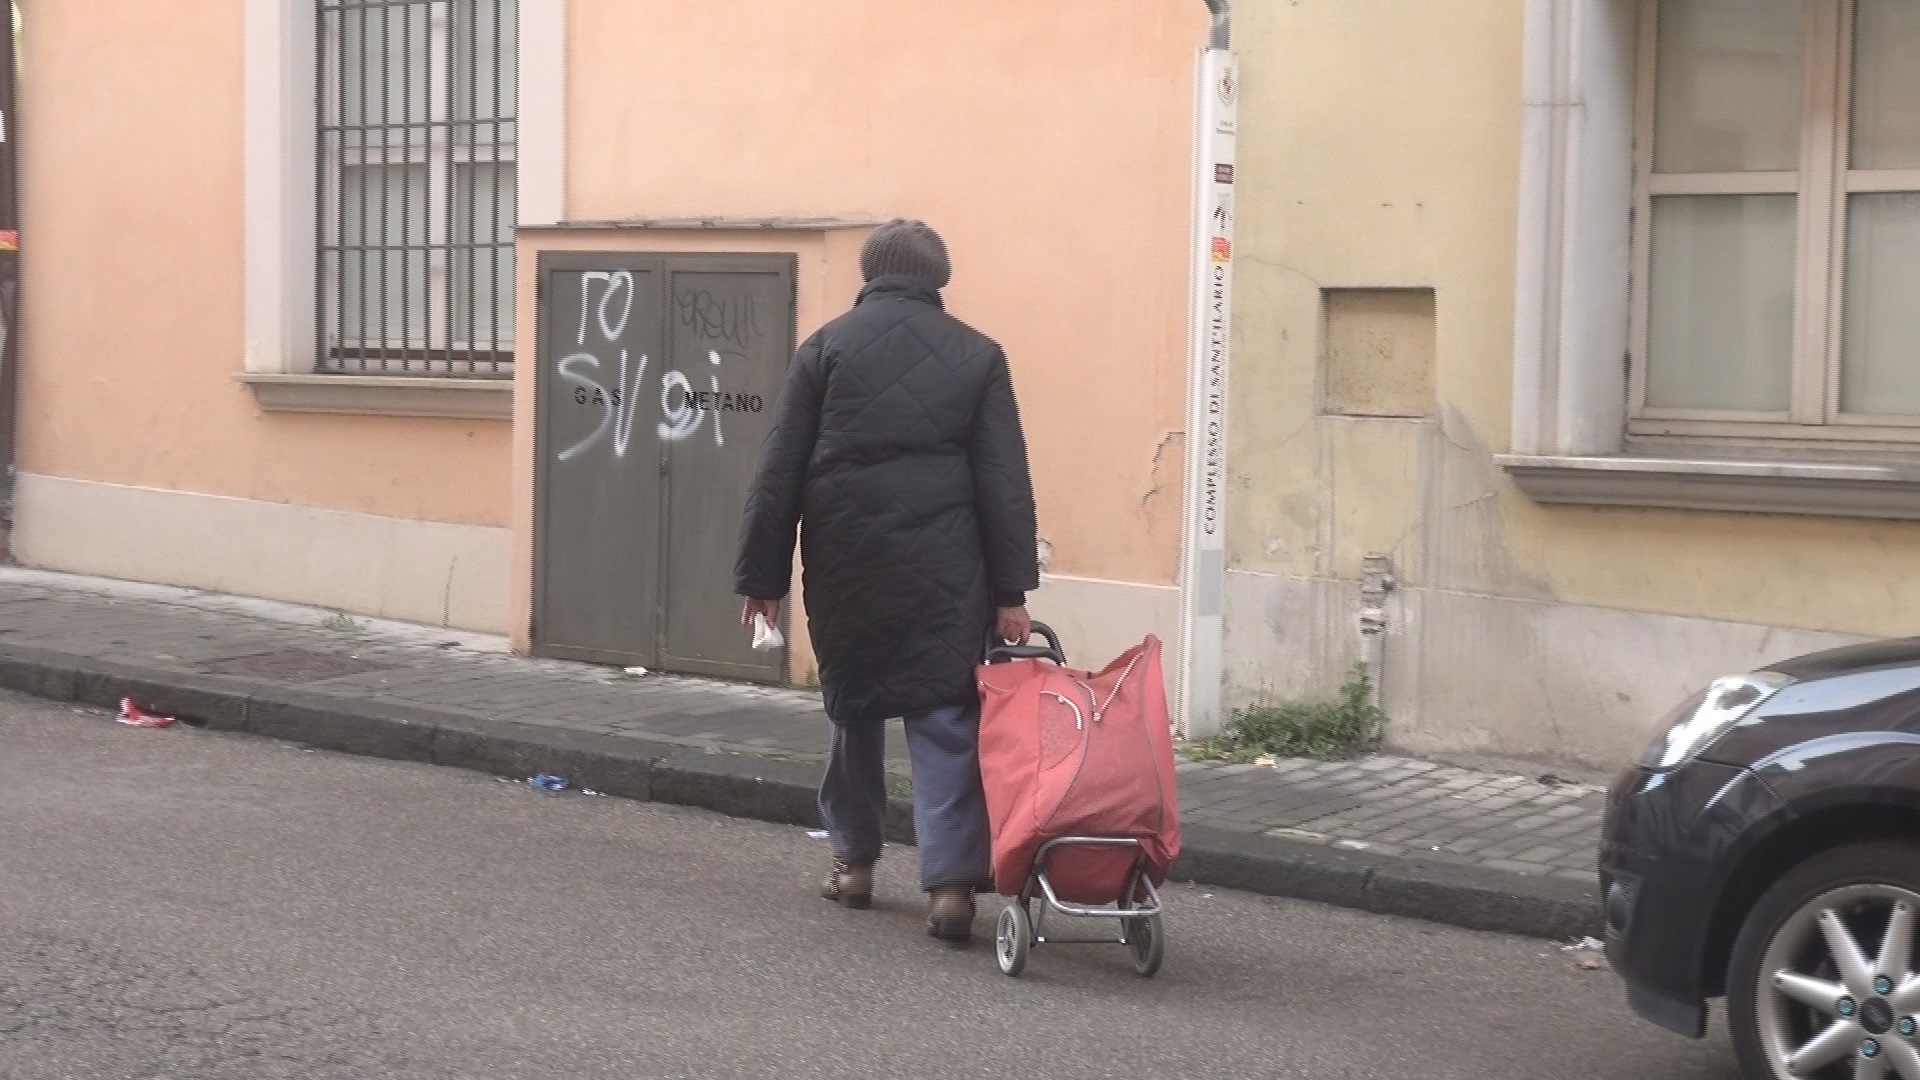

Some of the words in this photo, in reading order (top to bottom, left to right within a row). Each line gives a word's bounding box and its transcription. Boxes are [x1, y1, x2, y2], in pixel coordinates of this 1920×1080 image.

[1210, 265, 1224, 387] SANT'ILARIO
[574, 386, 621, 408] GAS
[684, 391, 763, 413] METANO
[1209, 394, 1220, 414] DI
[1204, 421, 1219, 535] COMPLESSO
